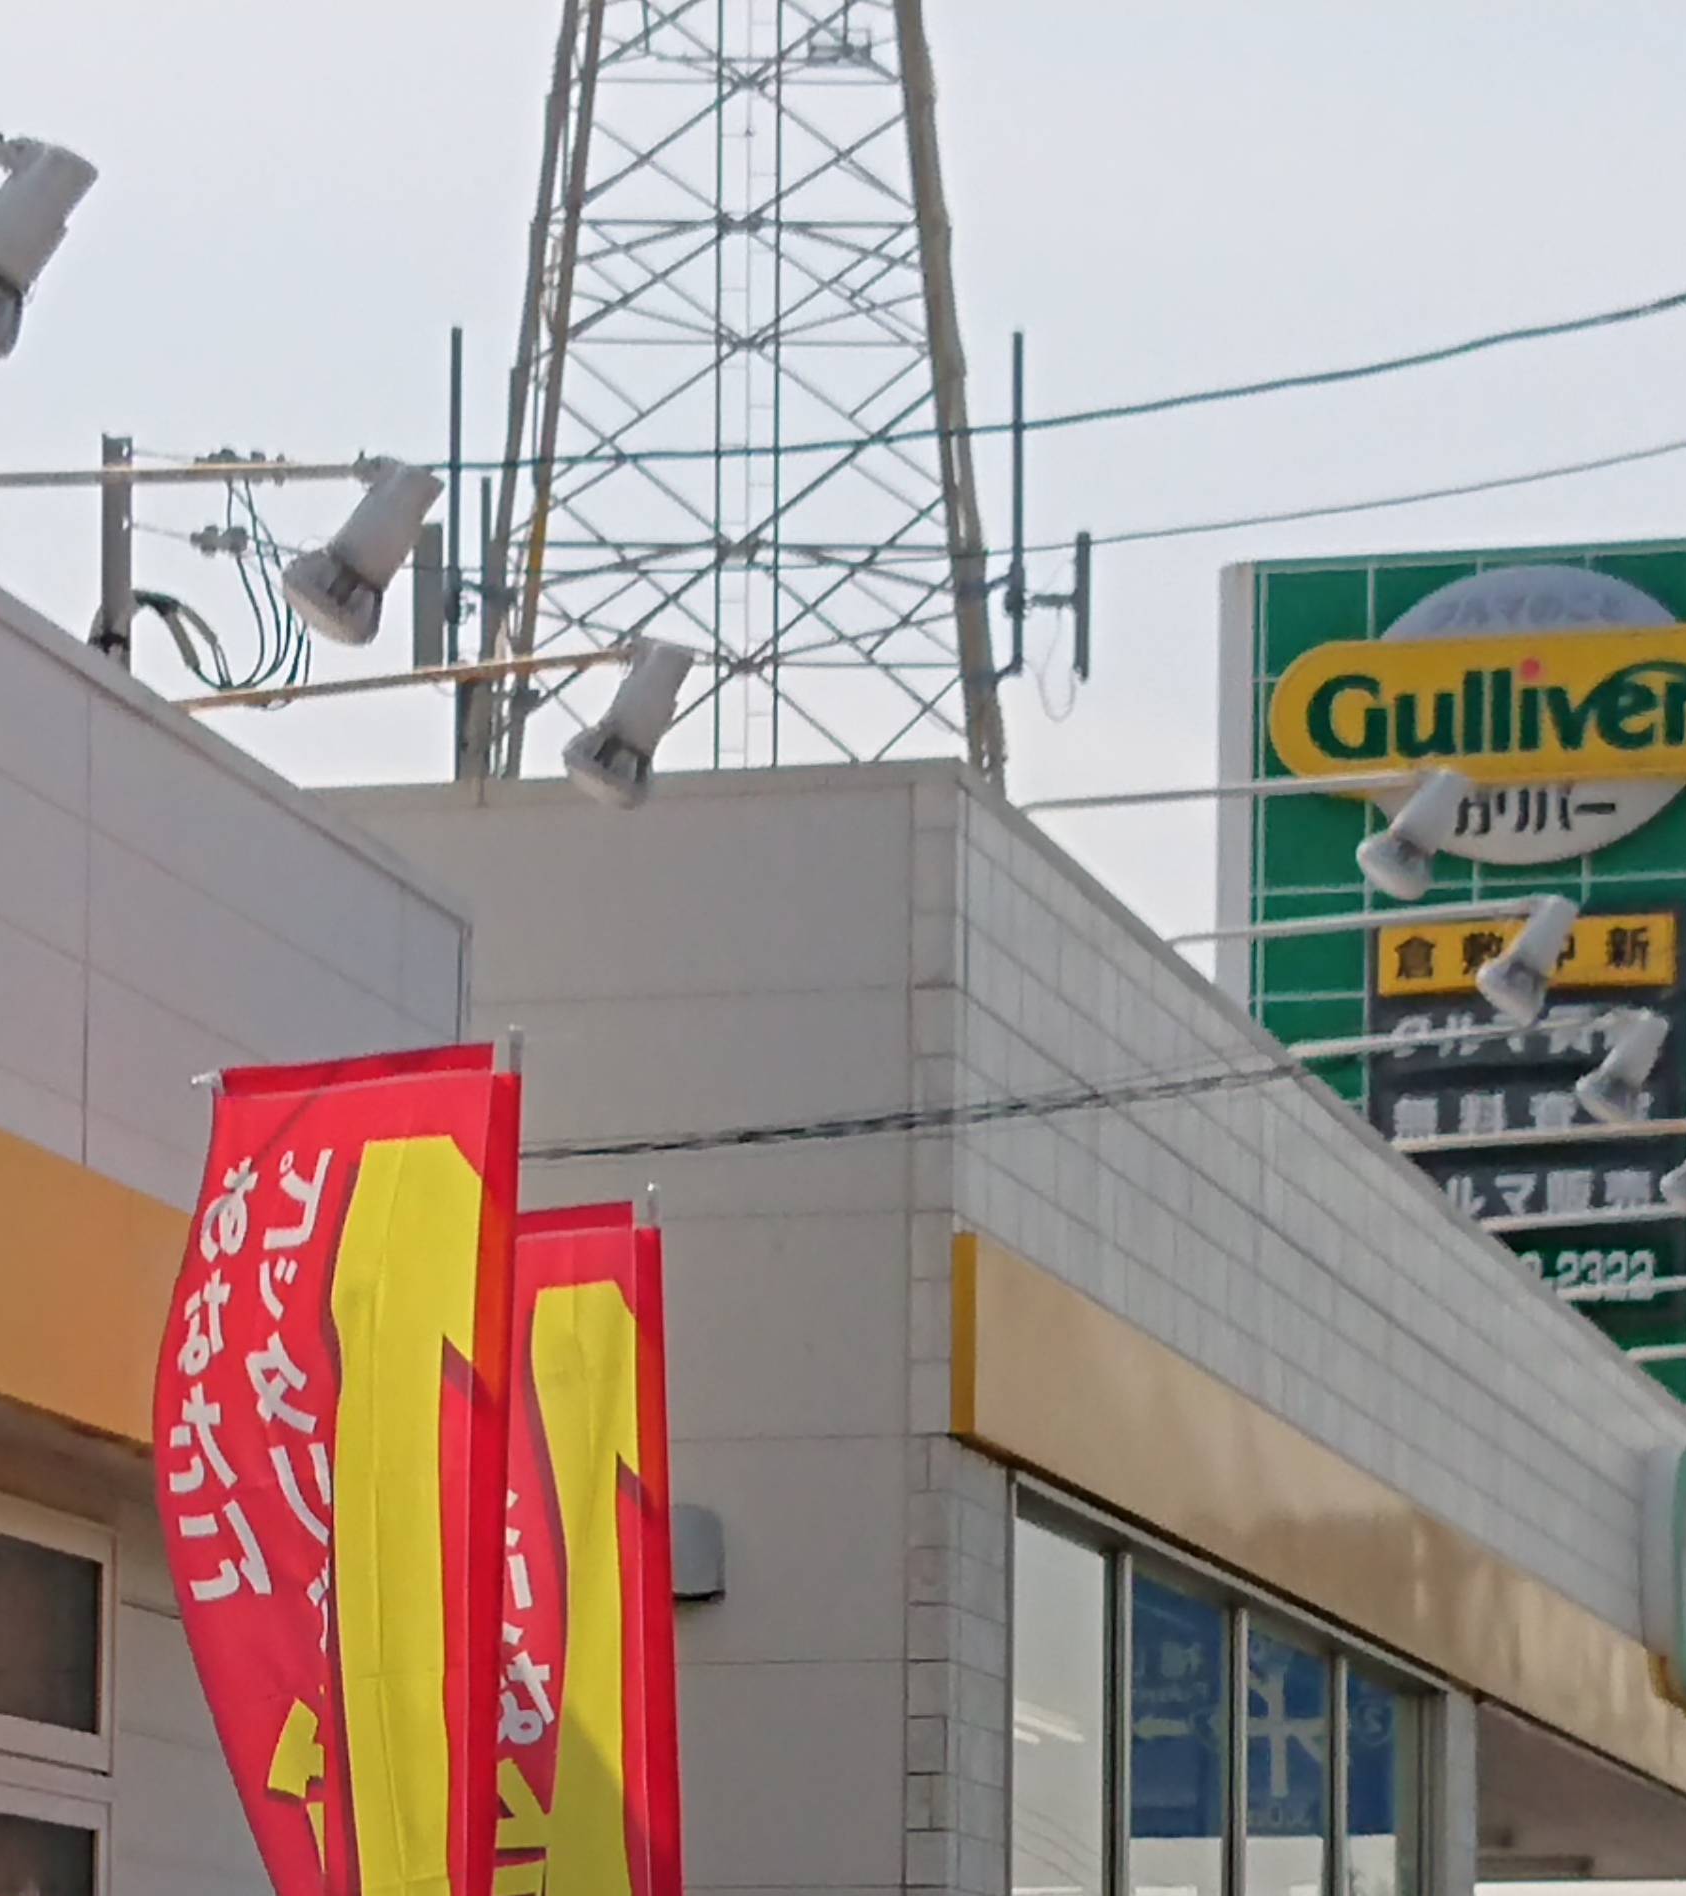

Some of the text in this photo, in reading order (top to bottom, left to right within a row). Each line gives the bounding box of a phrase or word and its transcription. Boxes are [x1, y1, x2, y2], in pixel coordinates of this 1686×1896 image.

[1393, 1004, 1619, 1059] クルマ買
[1444, 1168, 1653, 1219] ルマ販売
